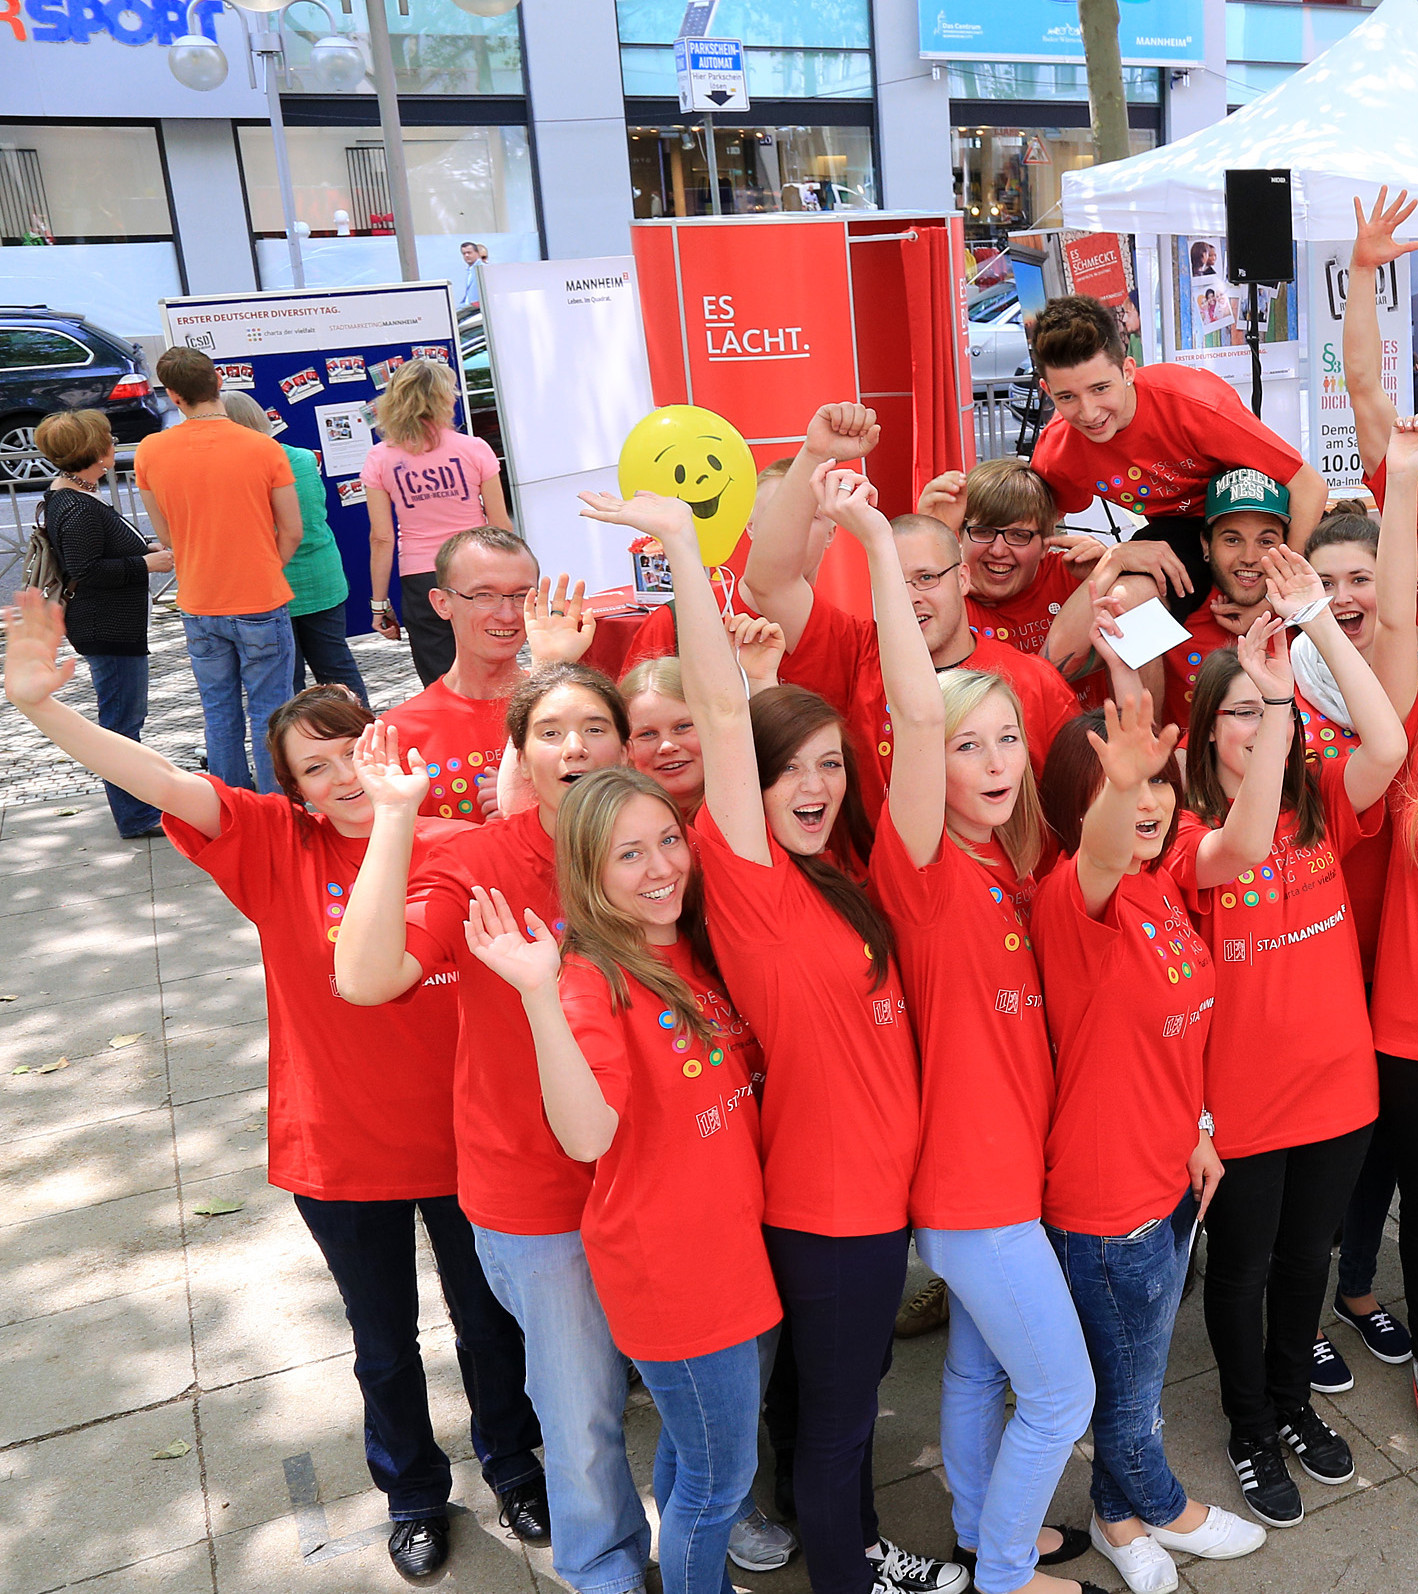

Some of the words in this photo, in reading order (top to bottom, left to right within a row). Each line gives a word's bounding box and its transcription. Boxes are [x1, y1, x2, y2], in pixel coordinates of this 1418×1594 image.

[689, 42, 739, 56] PARKSCHEIN-
[698, 57, 733, 69] AUTOMAT
[708, 73, 742, 81] Parkschein
[1070, 249, 1080, 261] ES
[1072, 251, 1117, 273] SCHMECKT.
[177, 316, 212, 325] ERSTER
[213, 311, 269, 322] DEUTSCHER
[271, 307, 319, 319] DIVERSITY
[320, 306, 341, 315] TAG.
[702, 295, 735, 320] ES
[706, 327, 810, 354] LACHT.
[1175, 354, 1195, 362] ERSTER
[1196, 351, 1227, 360] DEUTSCHER
[1321, 396, 1347, 410] DICH
[1326, 439, 1344, 449] am
[1215, 467, 1279, 498] MITCHELL
[1229, 483, 1265, 503] NESS
[1307, 851, 1335, 874] 2013
